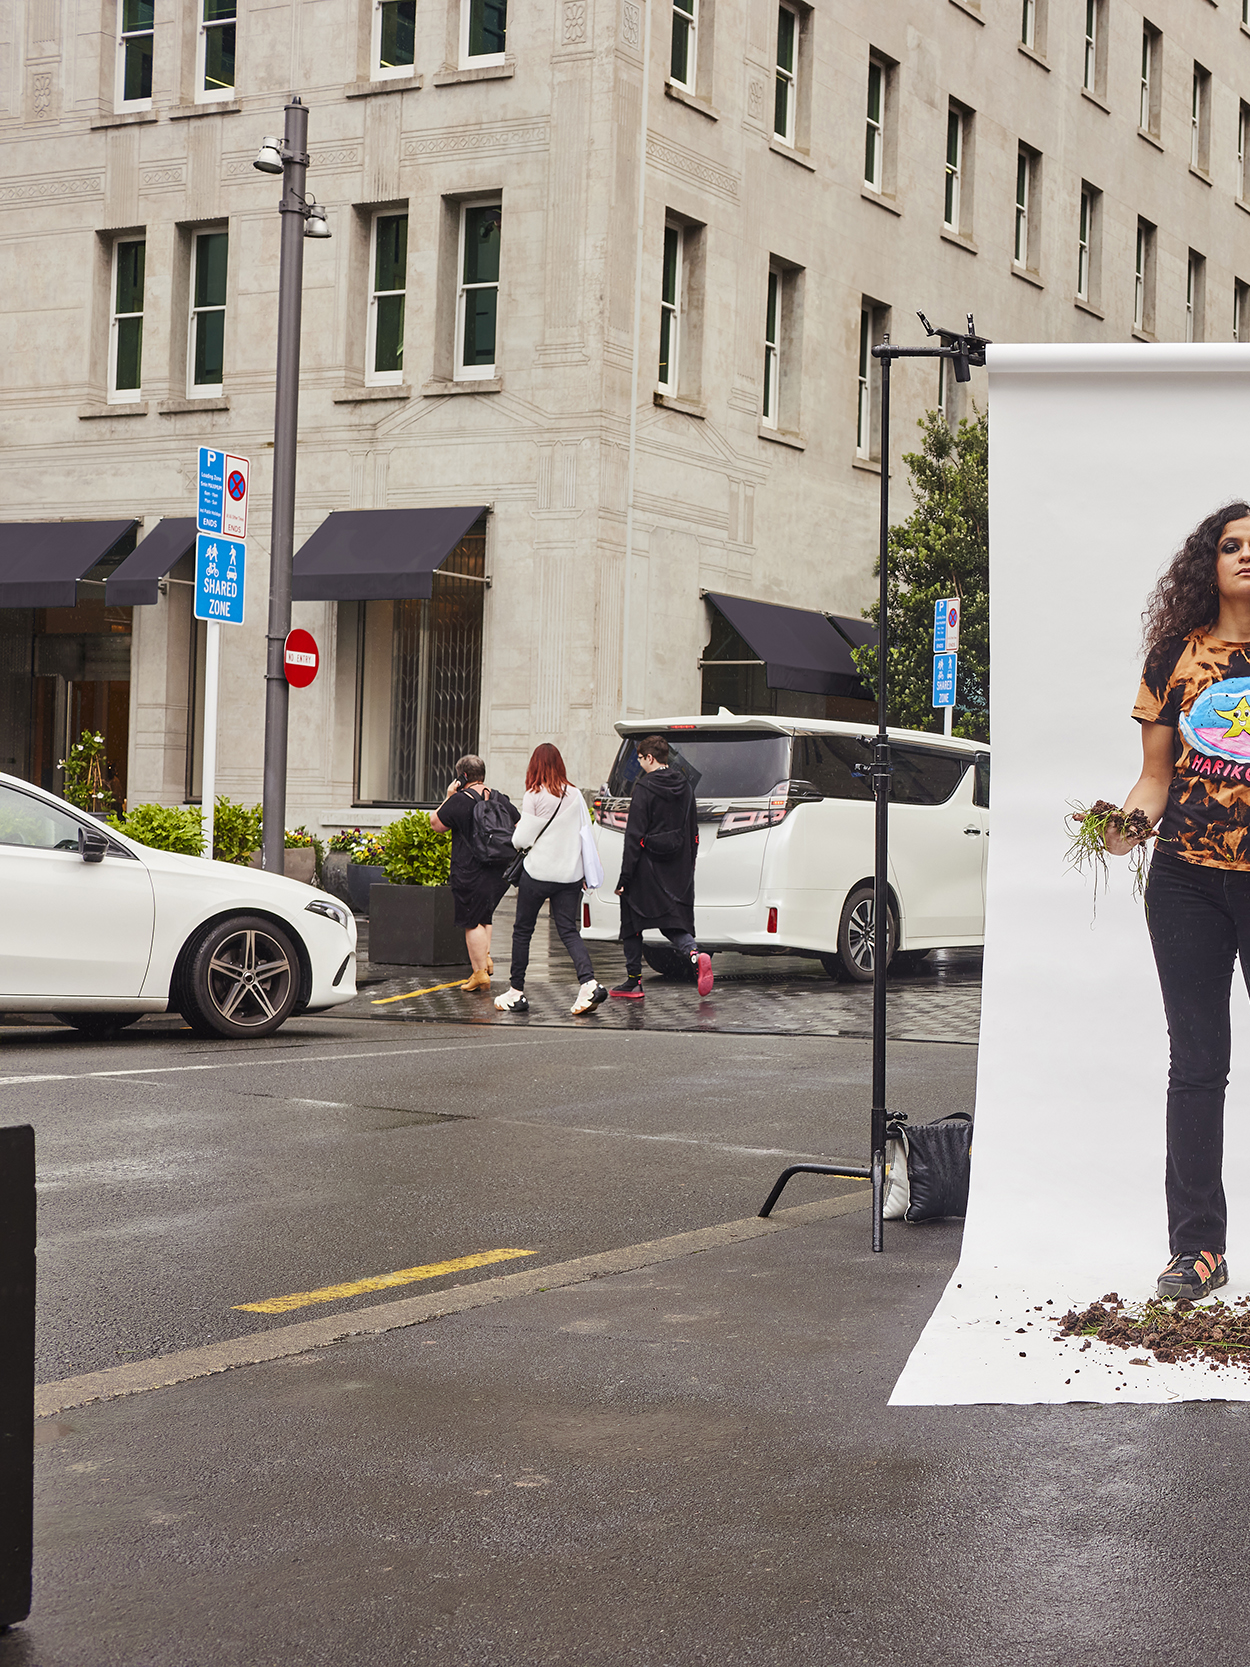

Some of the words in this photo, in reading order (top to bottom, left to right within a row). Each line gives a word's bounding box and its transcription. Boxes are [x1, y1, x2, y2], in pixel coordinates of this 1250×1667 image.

[207, 450, 216, 467] P
[202, 518, 218, 528] ENDS
[228, 524, 241, 534] ENDS
[204, 578, 238, 598] SHARED
[209, 599, 231, 617] ZONE
[939, 601, 944, 612] P
[288, 653, 294, 662] NO
[297, 654, 311, 663] ENTRY
[936, 680, 952, 690] SHARED
